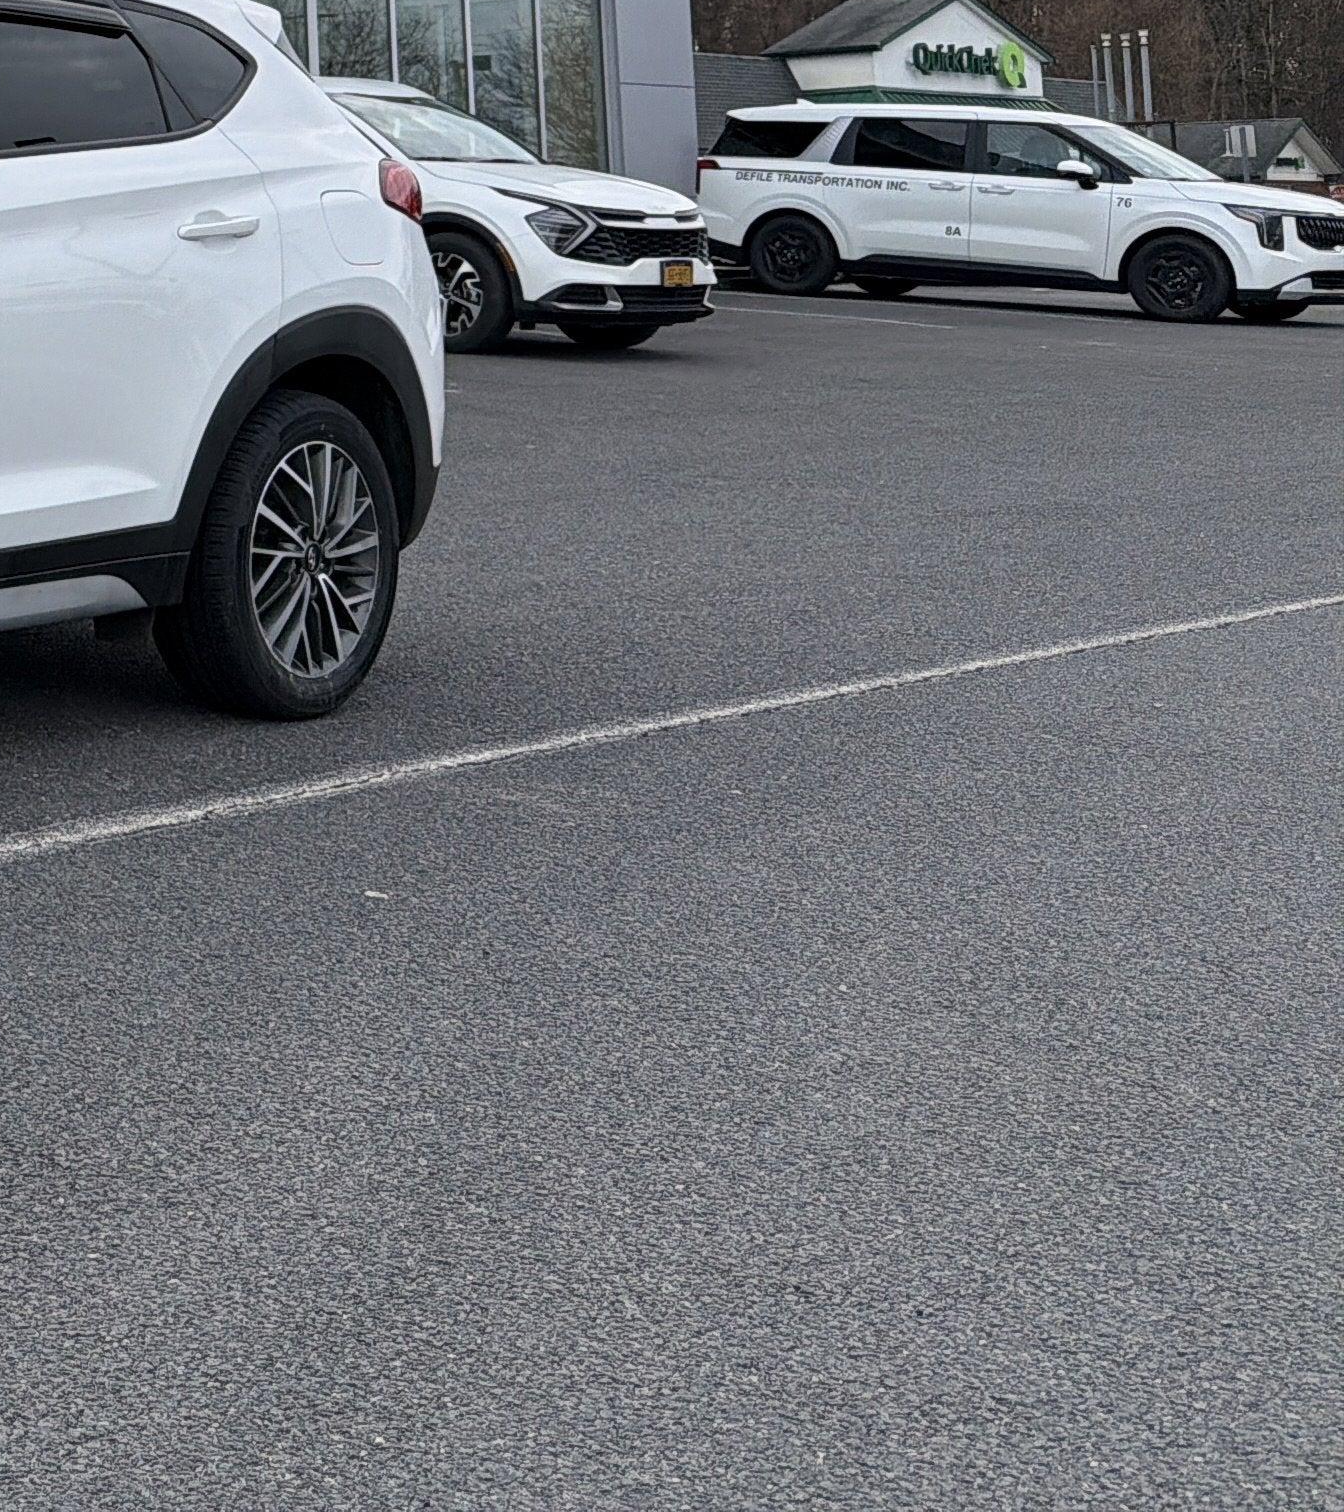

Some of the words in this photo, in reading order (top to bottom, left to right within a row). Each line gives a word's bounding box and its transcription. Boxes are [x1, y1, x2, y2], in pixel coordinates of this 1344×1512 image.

[735, 171, 773, 183] DEFILE
[777, 173, 883, 190] TRANSPORTATION
[886, 180, 911, 192] INC.
[1116, 197, 1133, 208] 76
[945, 226, 962, 237] 8A
